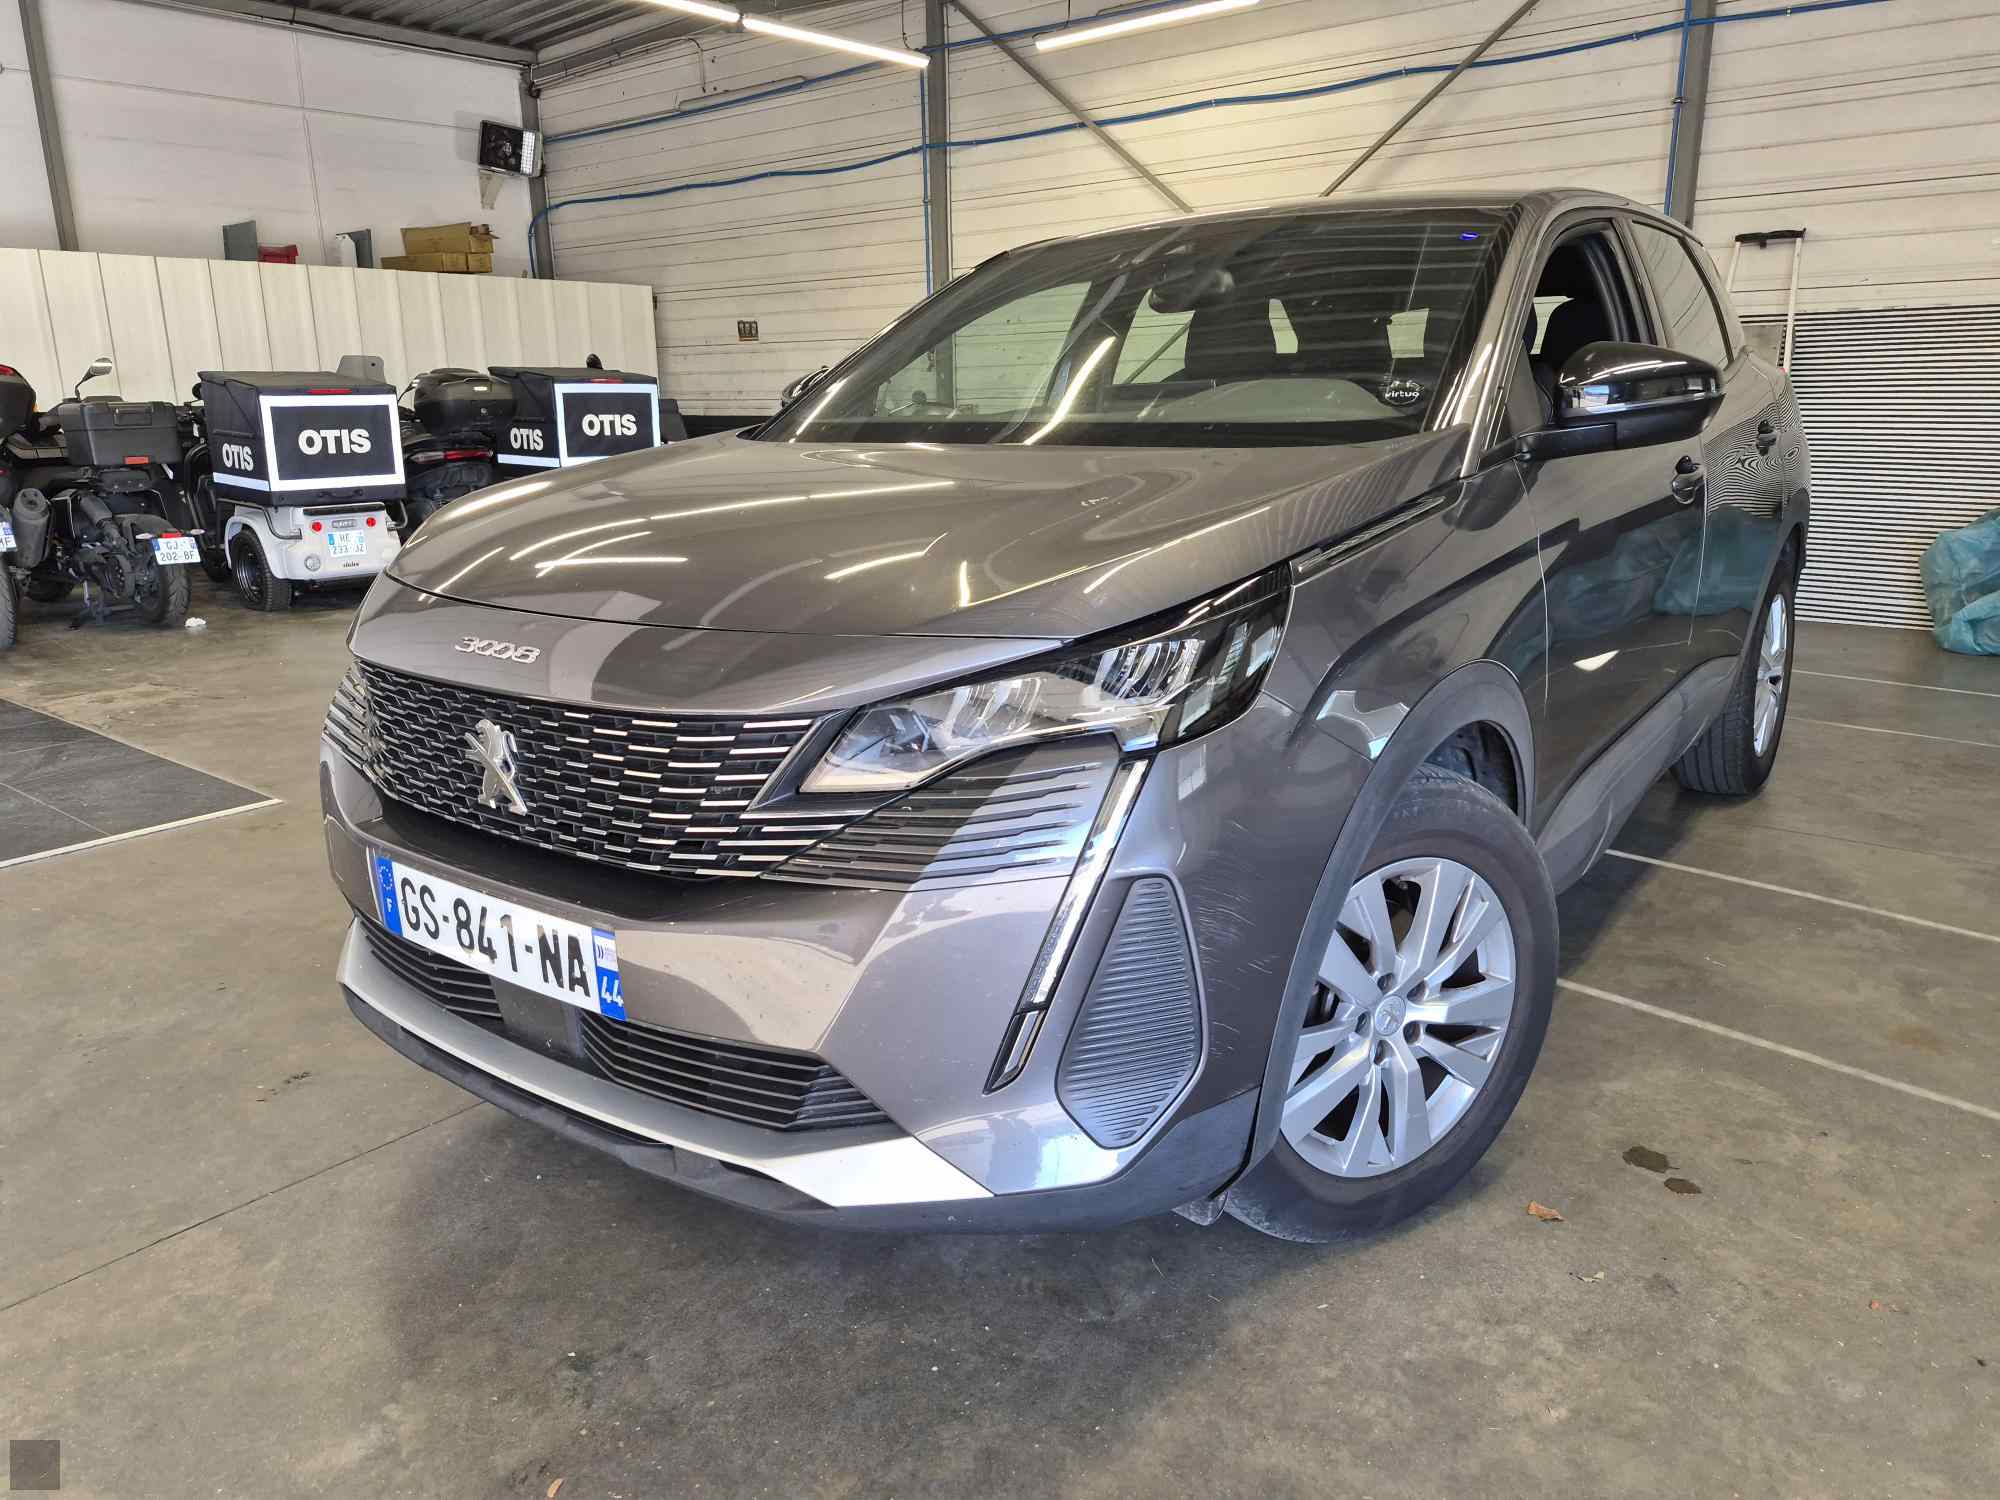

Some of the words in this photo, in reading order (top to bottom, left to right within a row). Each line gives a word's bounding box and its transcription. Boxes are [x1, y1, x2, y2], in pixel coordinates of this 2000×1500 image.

[1384, 390, 1420, 398] virtuo
[582, 413, 638, 437] OTIS
[298, 428, 372, 455] OTIS
[510, 427, 544, 451] OTIS
[222, 442, 254, 472] OTIS
[454, 636, 541, 664] 3008
[400, 877, 591, 998] GS-841-NA
[601, 975, 625, 1008] 44
